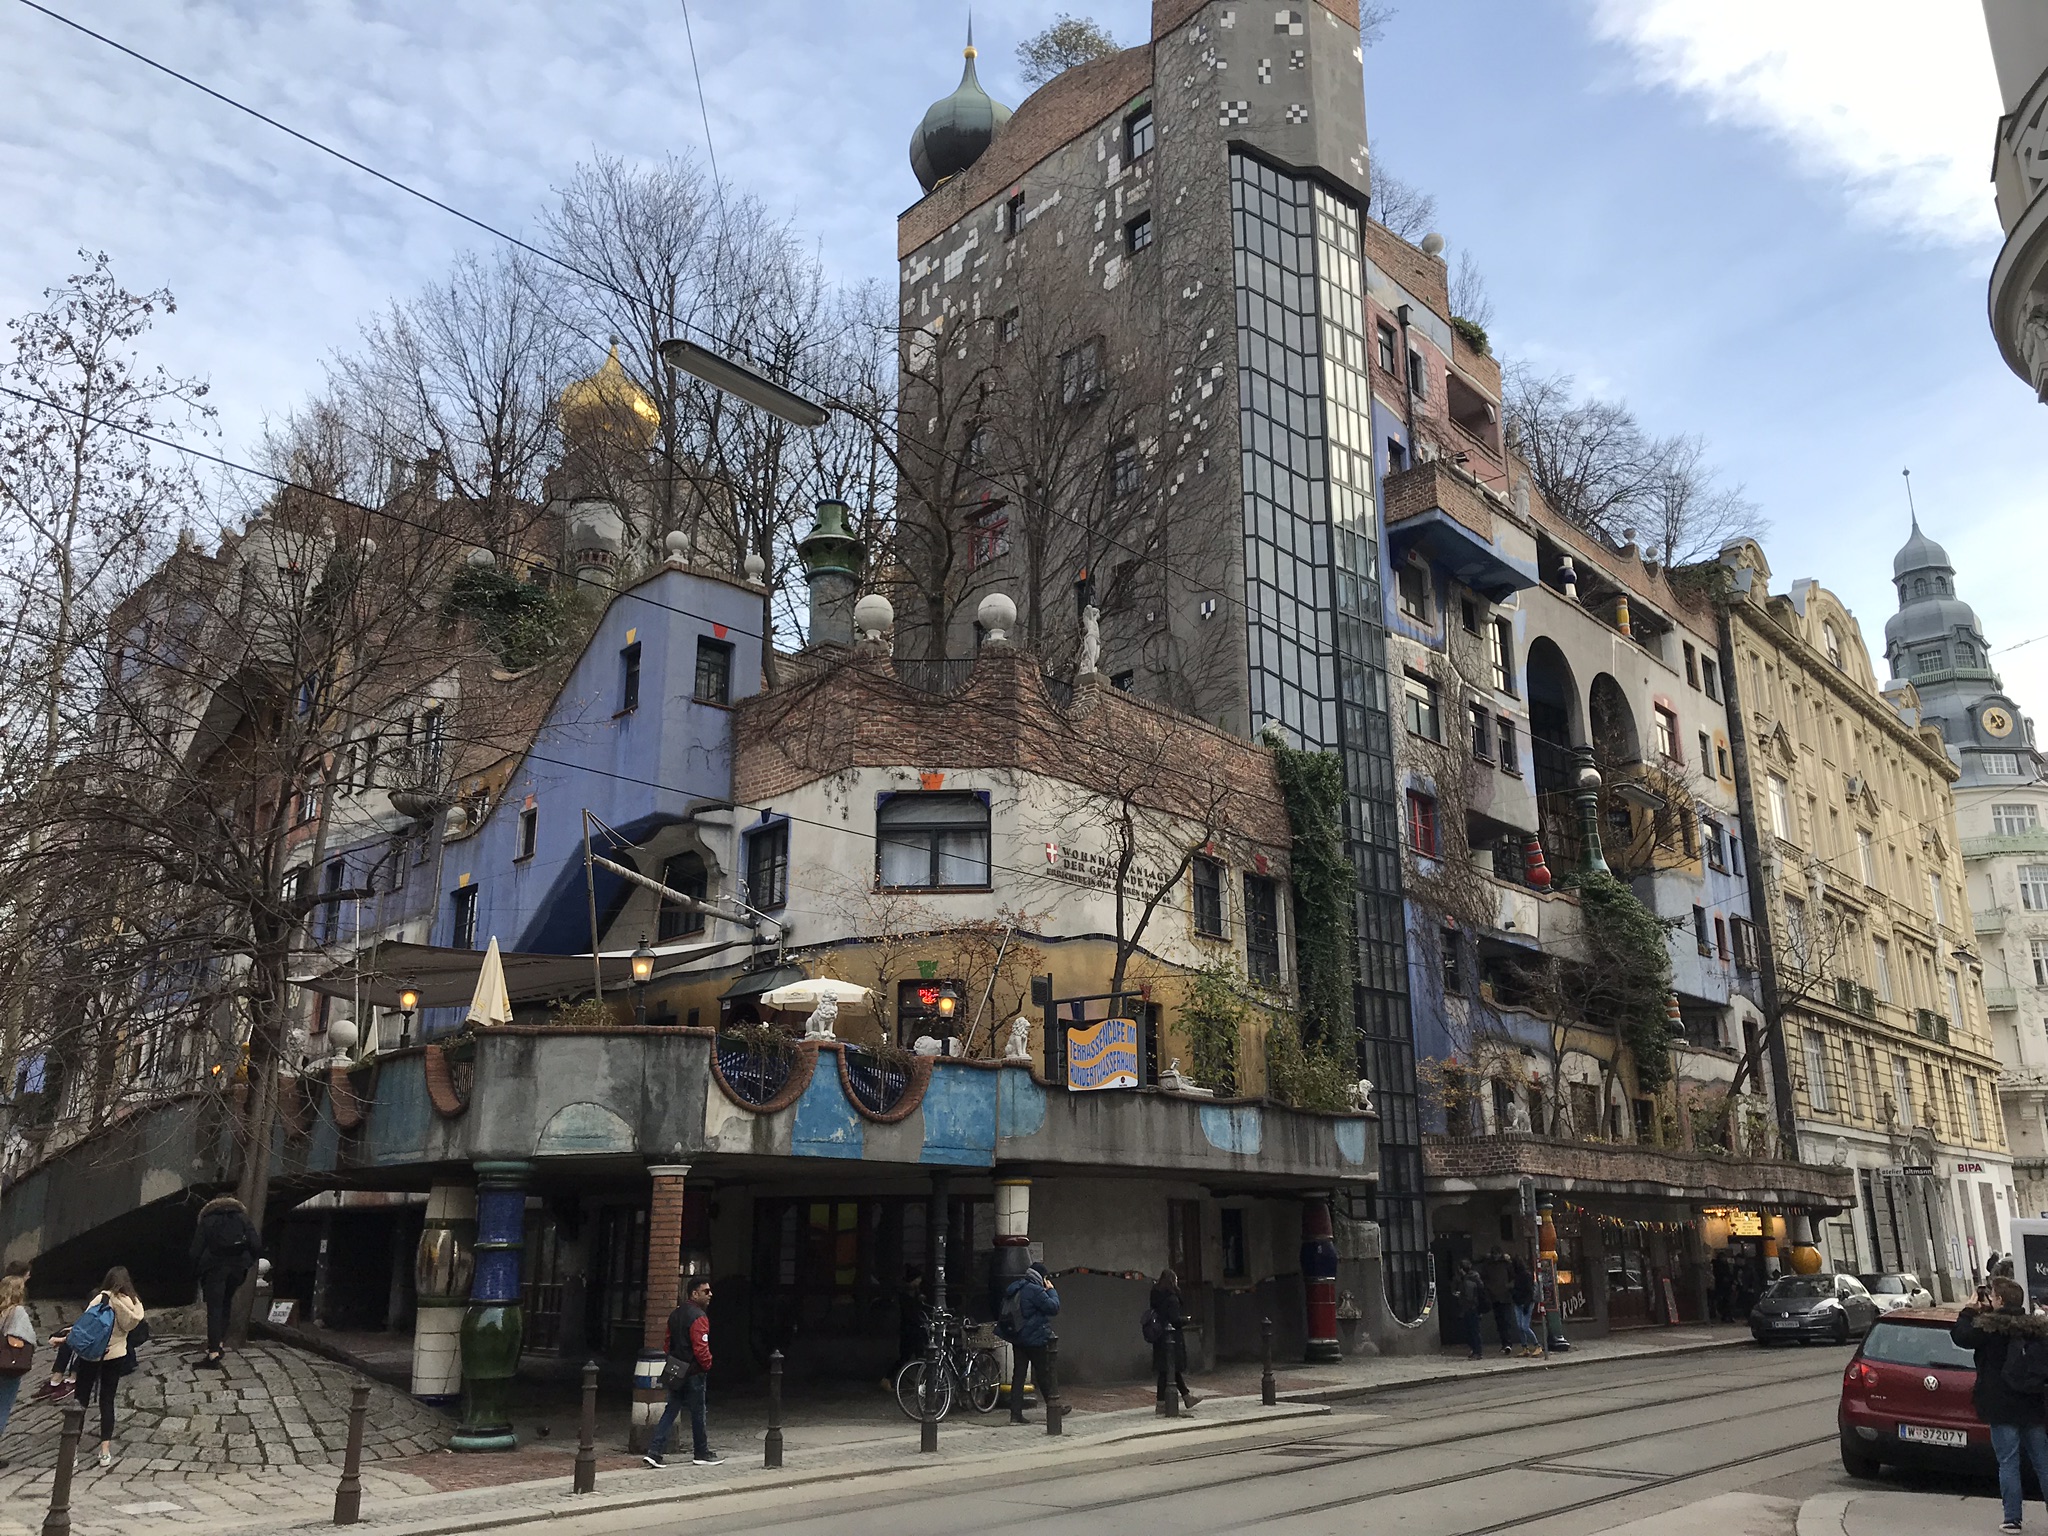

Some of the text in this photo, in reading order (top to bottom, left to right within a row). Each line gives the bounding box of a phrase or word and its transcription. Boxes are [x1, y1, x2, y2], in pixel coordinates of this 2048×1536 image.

[1062, 846, 1171, 883] WOHNHAANLAGE
[1063, 858, 1085, 873] DER
[1089, 865, 1144, 887] GEMENDE
[1069, 1050, 1137, 1087] HUNDERTWASSERHAUS
[1881, 1166, 1933, 1176] atelier altmann
[1957, 1163, 1983, 1173] BIPA
[1907, 1427, 1963, 1442] W 97207 Y
